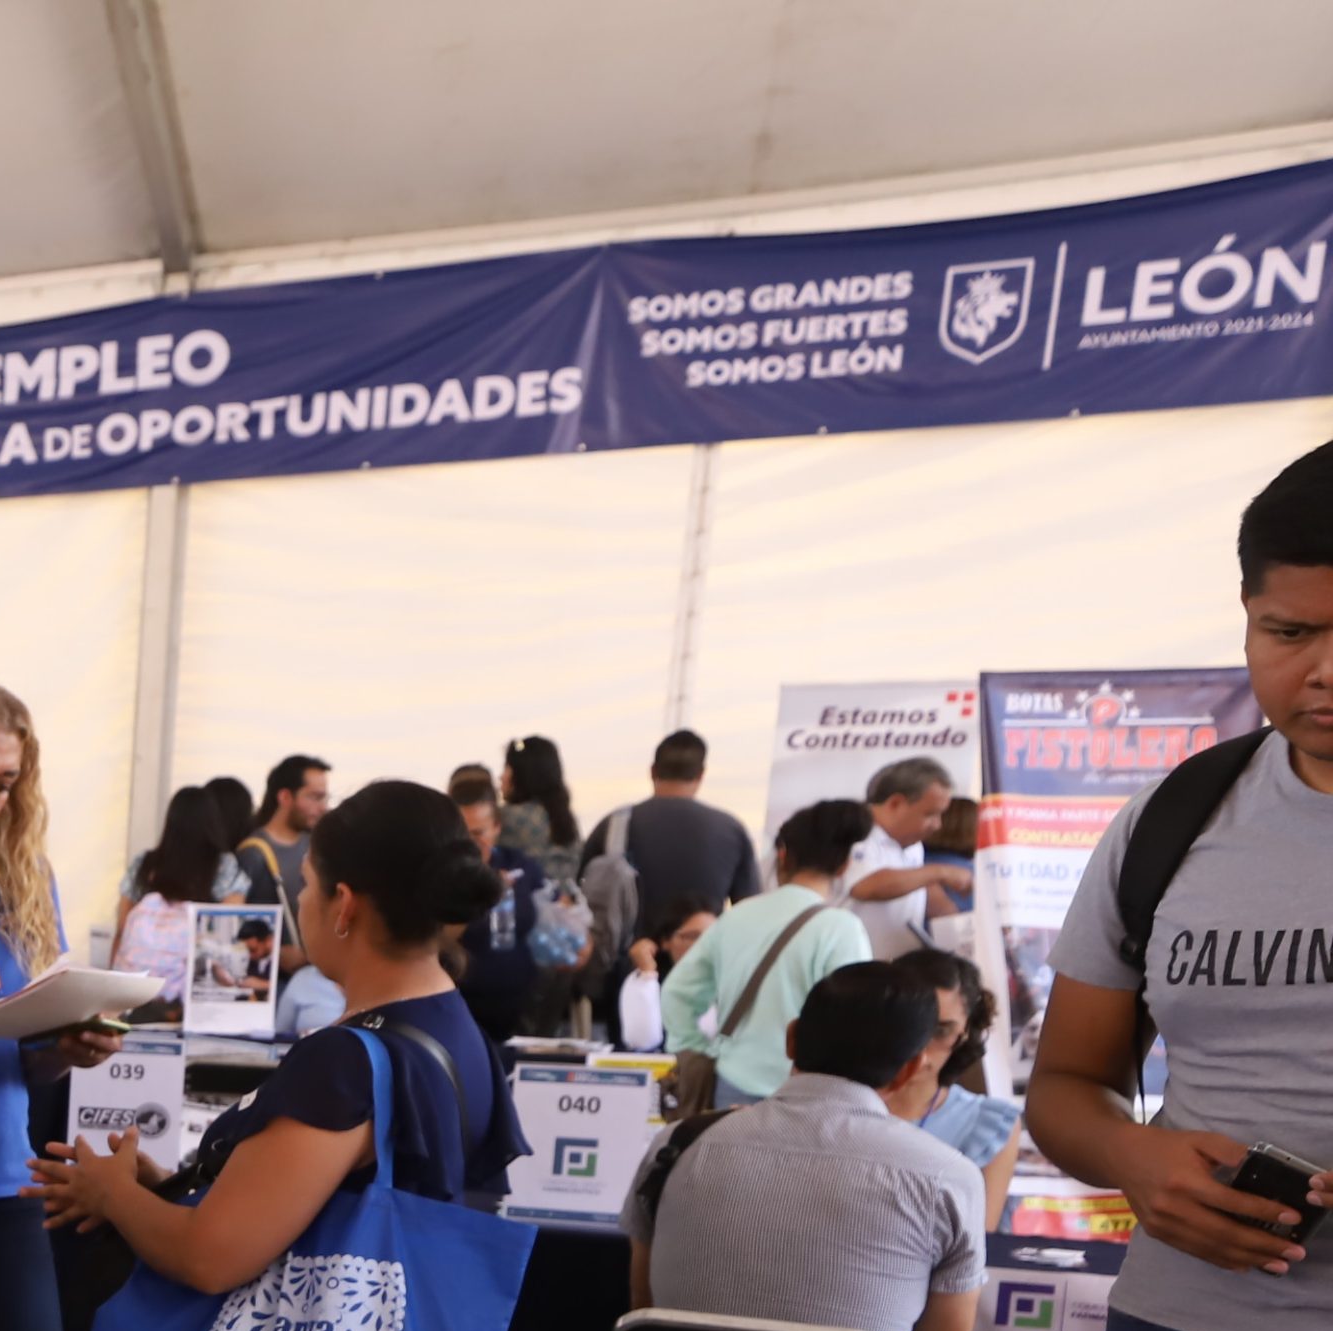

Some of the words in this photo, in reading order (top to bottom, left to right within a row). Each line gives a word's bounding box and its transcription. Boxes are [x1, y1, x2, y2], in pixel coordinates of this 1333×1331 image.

[628, 287, 745, 324] SOMOS
[749, 271, 913, 312] GRANDES
[1080, 232, 1327, 327] LEÓN
[640, 322, 758, 357] SOMOS
[762, 309, 908, 347] FUERTES
[1077, 320, 1219, 349] AYUNTAMIENTO
[685, 353, 806, 388] SOMOS
[810, 341, 904, 378] LEÓN
[43, 426, 92, 461] DE
[96, 366, 583, 456] OPORTUNIDADES
[819, 706, 938, 726] Estamos
[787, 728, 968, 748] Contratando
[1167, 929, 1333, 986] CALVIN
[110, 1064, 145, 1080] 039
[79, 1108, 134, 1125] CIFES
[558, 1095, 601, 1114] 040
